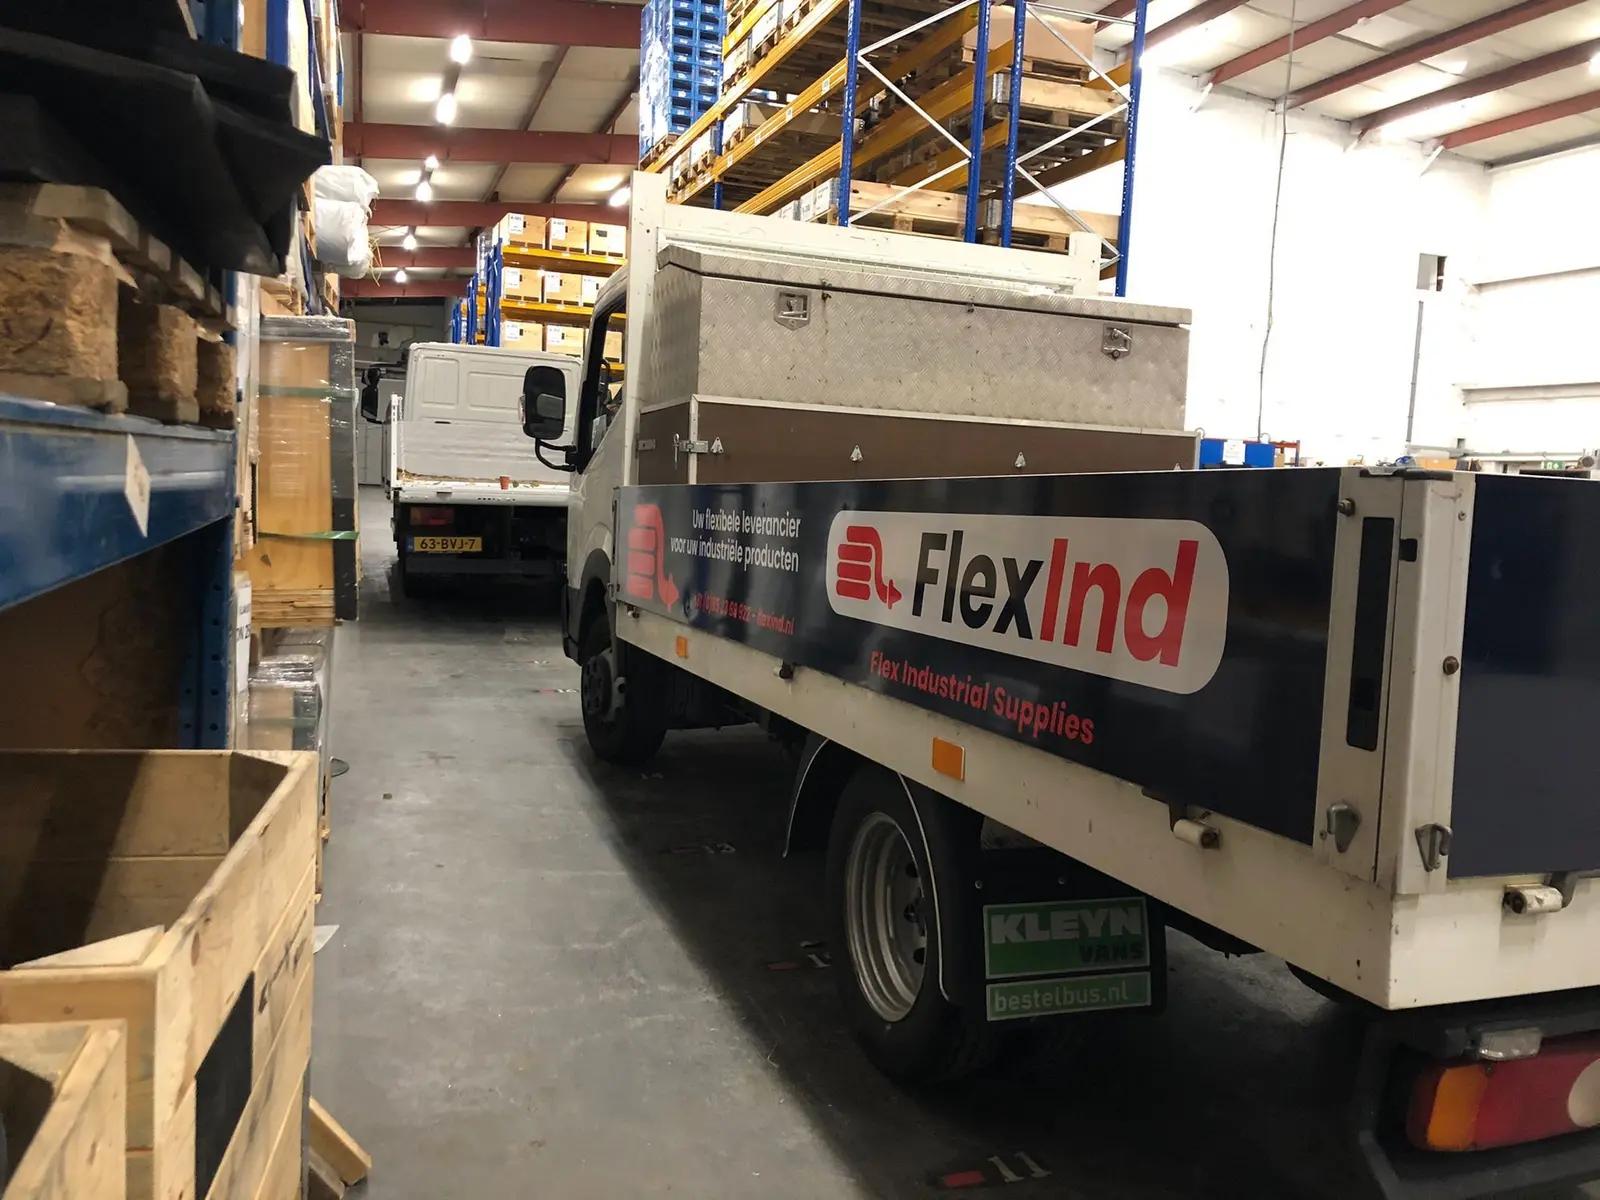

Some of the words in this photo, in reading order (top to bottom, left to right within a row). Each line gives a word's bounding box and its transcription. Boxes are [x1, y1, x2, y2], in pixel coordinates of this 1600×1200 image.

[692, 509, 704, 529] Uw
[705, 508, 740, 532] flexibele
[741, 510, 801, 538] leverancier
[670, 537, 686, 553] voor
[686, 538, 698, 556] uw
[699, 536, 743, 562] industriële
[744, 544, 799, 573] producten
[911, 530, 1199, 667] FlexInd
[869, 650, 900, 683] Flex
[901, 659, 990, 712] Industrial
[992, 686, 1095, 746] Supplies
[990, 907, 1143, 944] KLEYN
[1080, 941, 1144, 964] VANS
[994, 980, 1128, 1012] bestelbus.nl
